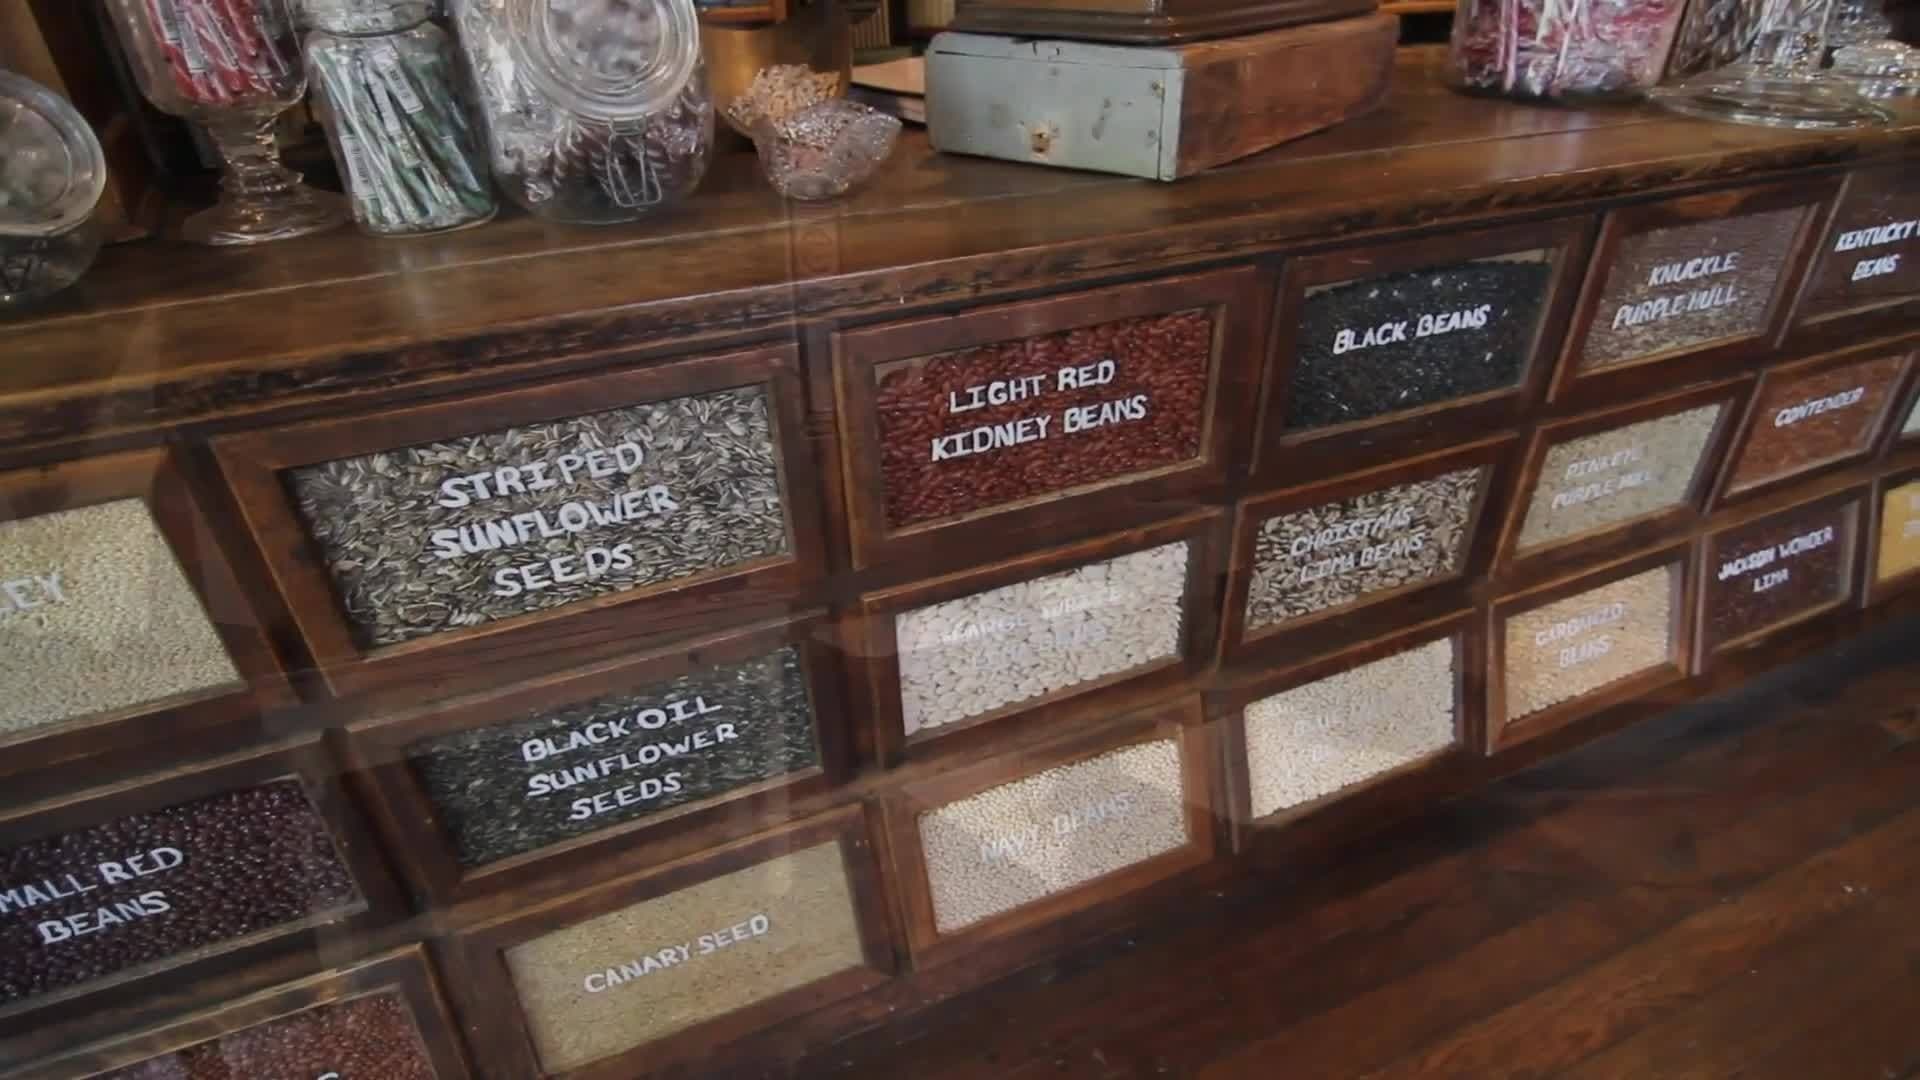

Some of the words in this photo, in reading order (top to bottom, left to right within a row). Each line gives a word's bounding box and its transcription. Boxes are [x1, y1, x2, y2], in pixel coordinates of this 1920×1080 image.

[1834, 220, 1917, 252] KENTUCKY
[1647, 252, 1741, 287] KNUCKLE
[1851, 254, 1901, 281] BEANS
[1333, 321, 1409, 354] BLACK
[1415, 304, 1491, 338] BEANS
[1611, 293, 1687, 330] PURPLE
[1687, 284, 1739, 312] HULL
[949, 374, 1047, 413] LIGHT
[1057, 359, 1116, 391] RED
[1774, 386, 1865, 428] CONTENDER
[930, 415, 1052, 461] KIDNEY
[1063, 394, 1147, 433] BEANS
[438, 442, 644, 508] STRIPED
[430, 484, 680, 560] SUNFLOWER
[1290, 506, 1415, 557] CHRISTMAS
[493, 543, 634, 598] SEEDS
[1299, 554, 1355, 584] LIMA
[1359, 533, 1427, 568] BEANS
[1718, 546, 1776, 581] JACKSON
[1778, 526, 1833, 559] WONDER
[1753, 567, 1790, 593] LIMA
[522, 717, 631, 762] BLACK
[636, 696, 722, 730] OIL
[526, 723, 739, 797] SUNFLOWER
[567, 772, 683, 821] SEEDS
[99, 847, 184, 885] RED
[979, 823, 1039, 864] NAVY
[37, 891, 171, 945] BEANS
[583, 942, 691, 993] CANARY
[697, 914, 769, 955] SEED
